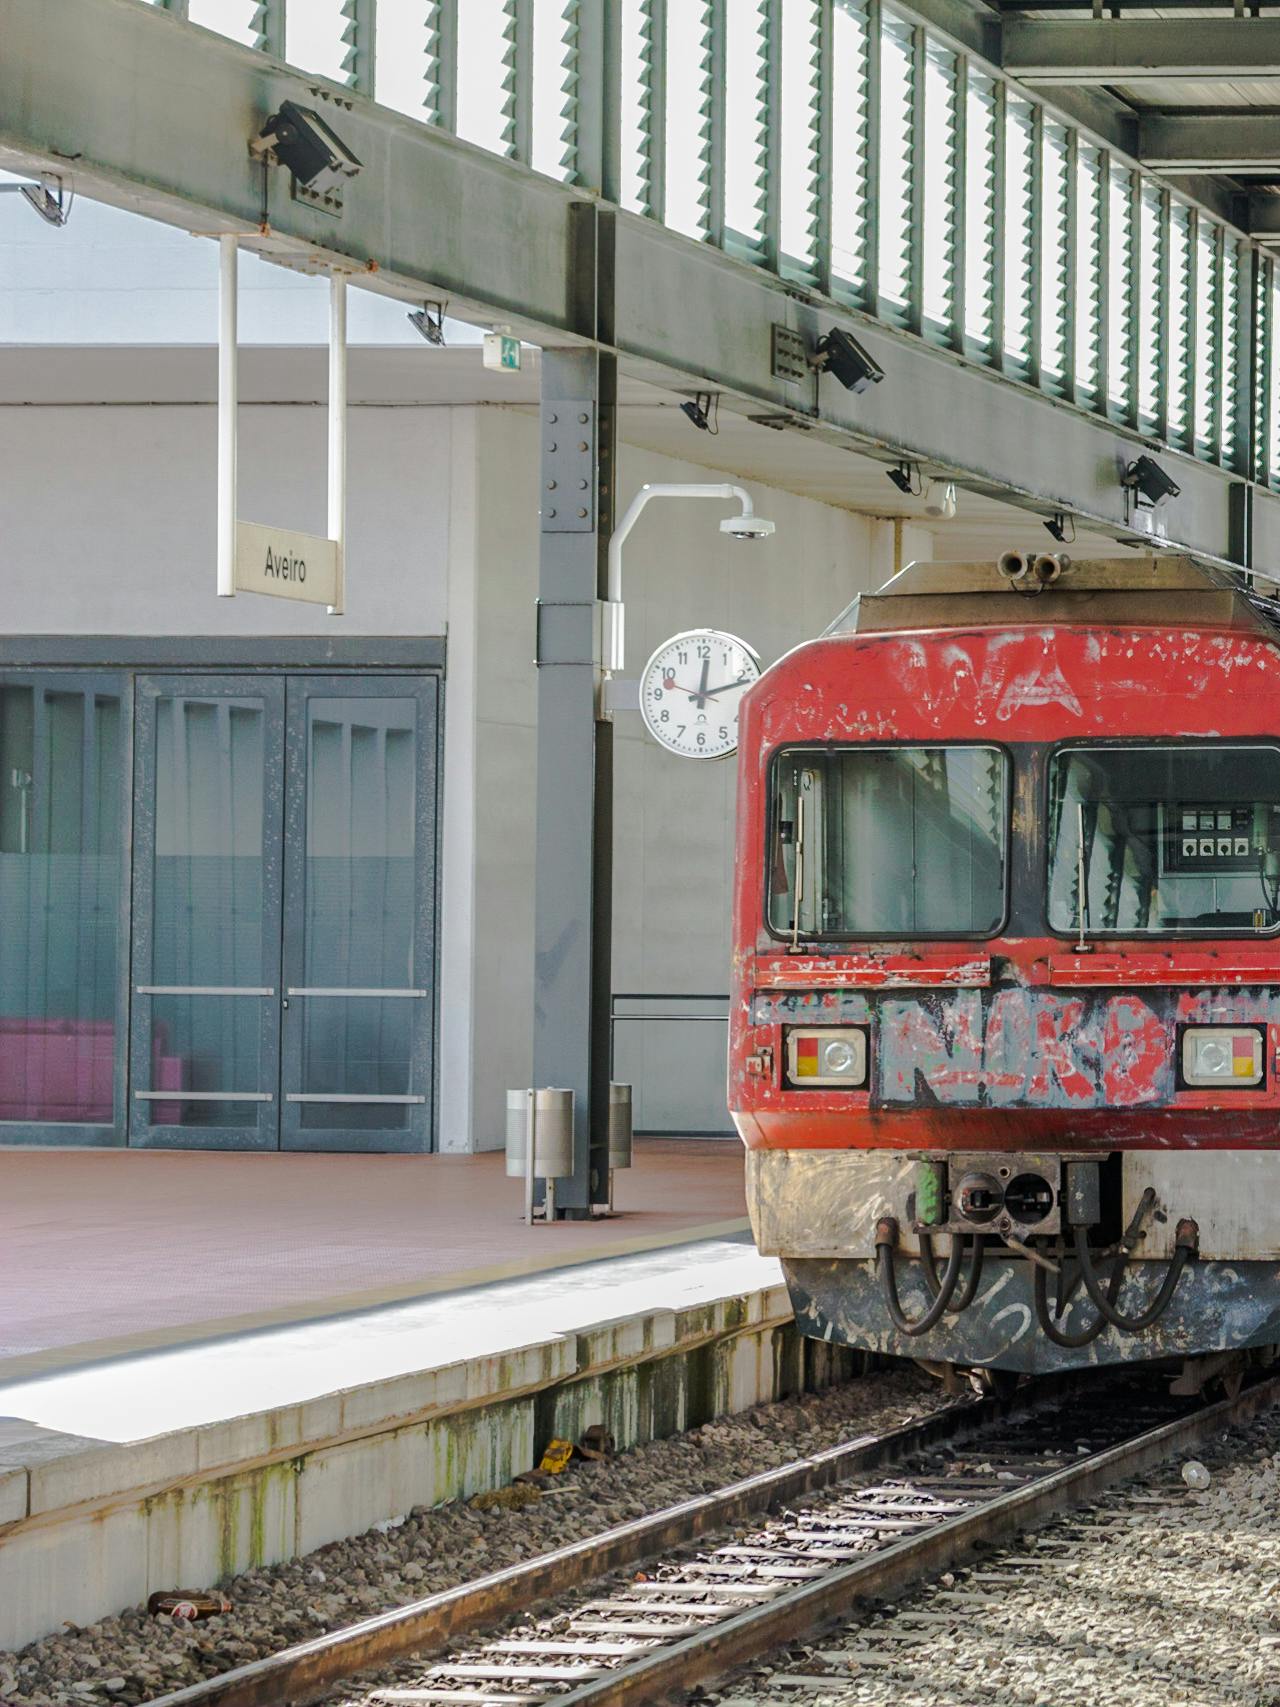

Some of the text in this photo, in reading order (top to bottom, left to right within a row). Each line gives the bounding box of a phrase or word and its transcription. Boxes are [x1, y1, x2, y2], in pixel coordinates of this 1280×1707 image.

[264, 545, 306, 583] Aveiro
[678, 652, 688, 665] 11
[697, 645, 711, 659] 12
[723, 653, 728, 666] 1
[662, 667, 676, 680] 10
[737, 669, 746, 681] 2
[653, 688, 663, 701] 9
[660, 709, 670, 723] 8
[676, 725, 686, 738] 7
[718, 727, 728, 739] 5
[696, 733, 706, 746] 6
